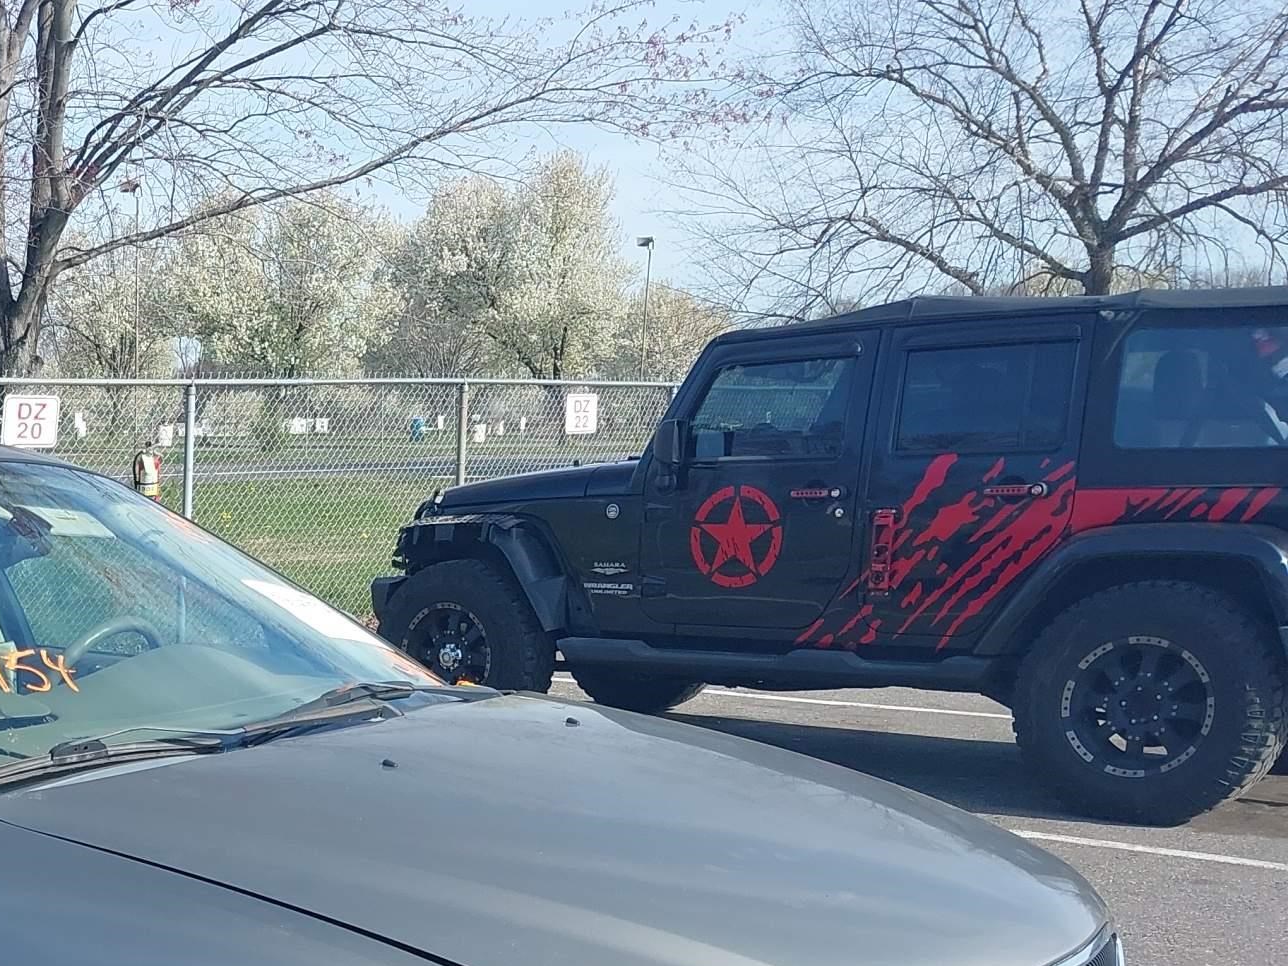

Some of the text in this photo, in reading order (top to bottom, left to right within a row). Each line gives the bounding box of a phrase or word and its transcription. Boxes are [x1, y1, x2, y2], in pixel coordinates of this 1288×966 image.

[18, 403, 47, 420] DZ
[574, 400, 590, 413] DZ
[575, 415, 589, 428] 22
[17, 422, 42, 439] 20
